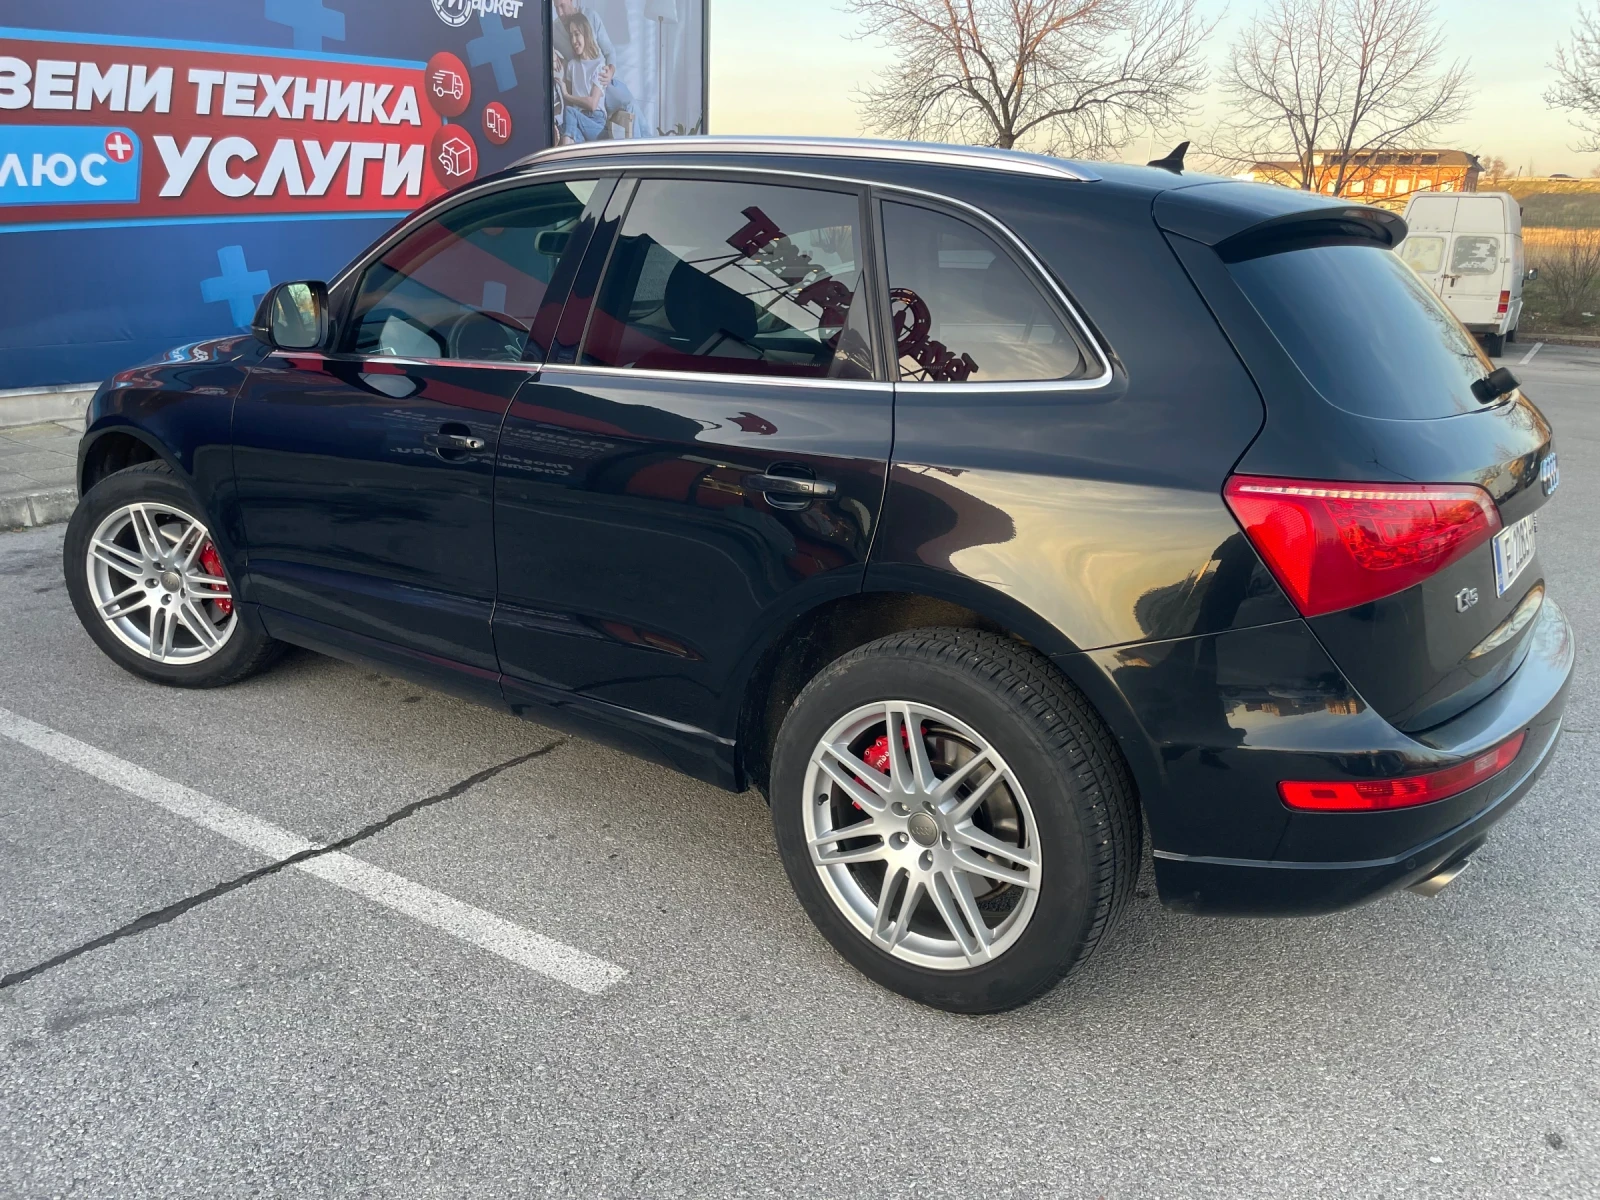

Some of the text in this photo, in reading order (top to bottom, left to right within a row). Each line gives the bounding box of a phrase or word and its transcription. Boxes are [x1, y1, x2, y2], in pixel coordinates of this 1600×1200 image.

[0, 56, 421, 126] ЗЕМИ ТЕХНИКА
[0, 134, 425, 197] ЛЮС УСЛУГИ
[1455, 587, 1479, 613] Q5
